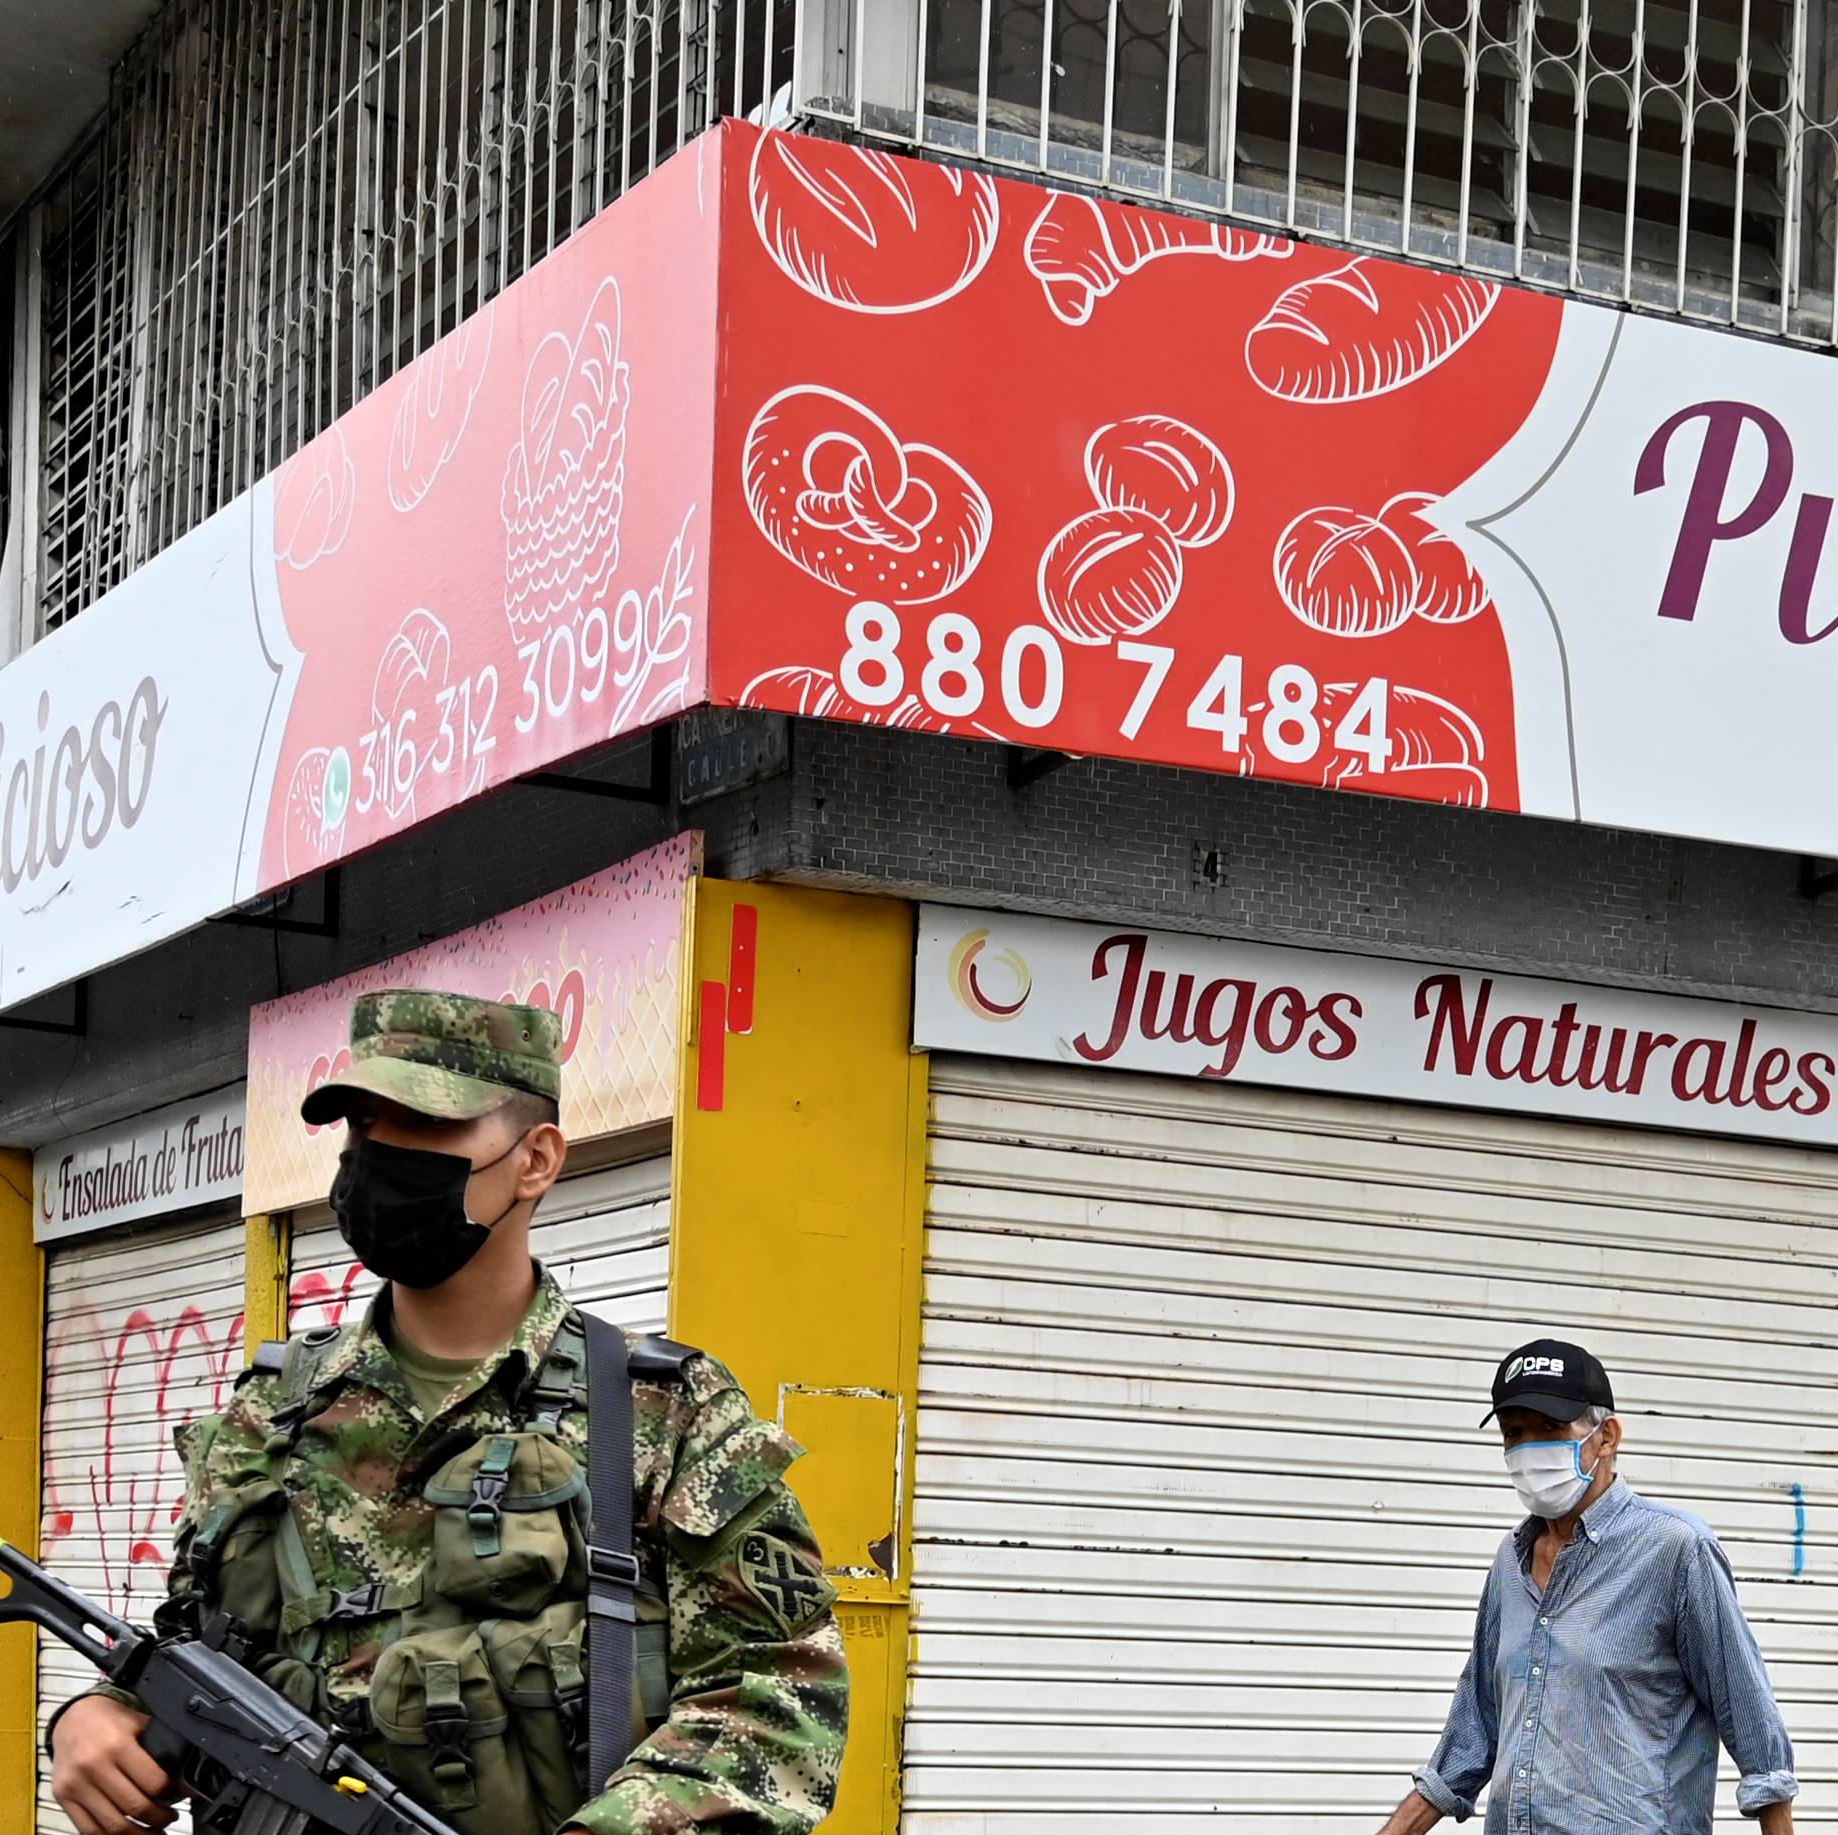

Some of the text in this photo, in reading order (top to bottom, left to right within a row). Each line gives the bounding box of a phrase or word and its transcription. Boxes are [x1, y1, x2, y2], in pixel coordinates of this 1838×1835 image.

[354, 707, 417, 815] 316
[434, 664, 498, 774] 312
[839, 601, 1394, 773] 880 7484
[1073, 933, 1837, 1117] Jugos Naturales
[59, 1114, 244, 1222] Ensalada de Fruta
